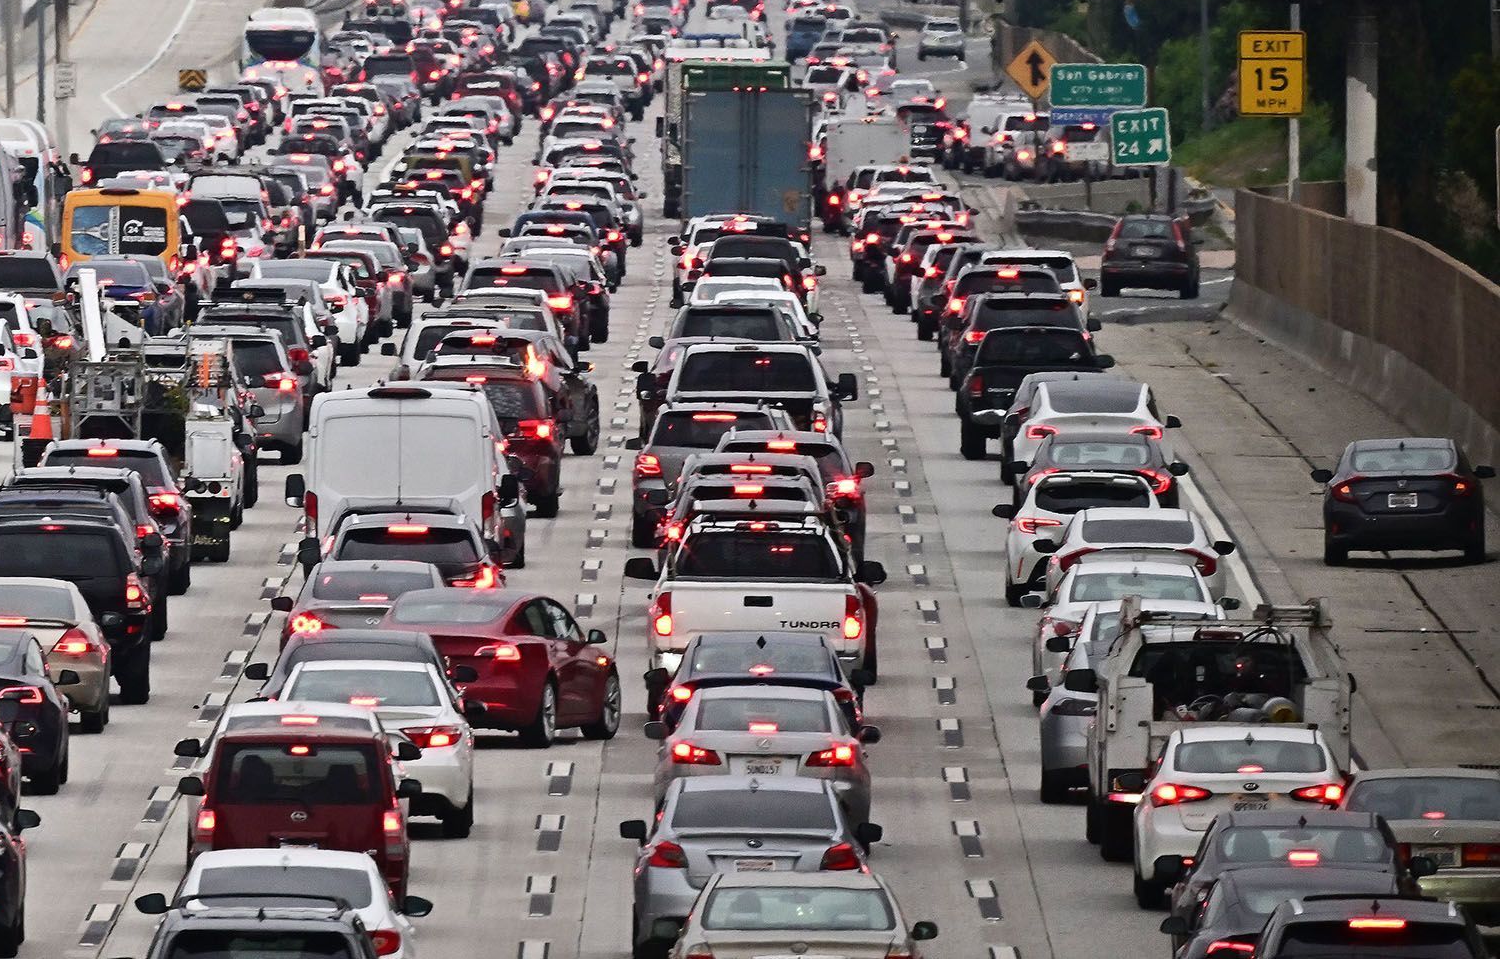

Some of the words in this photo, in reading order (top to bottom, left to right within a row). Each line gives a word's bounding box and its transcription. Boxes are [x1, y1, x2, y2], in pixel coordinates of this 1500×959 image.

[1253, 40, 1291, 53] EXIT
[1057, 69, 1082, 80] San
[1088, 69, 1140, 81] Gabriel
[1255, 67, 1289, 91] 15
[1256, 98, 1287, 108] MPH
[1118, 117, 1160, 133] EXIT
[1118, 140, 1140, 156] 24
[780, 620, 840, 629] TUNDRA
